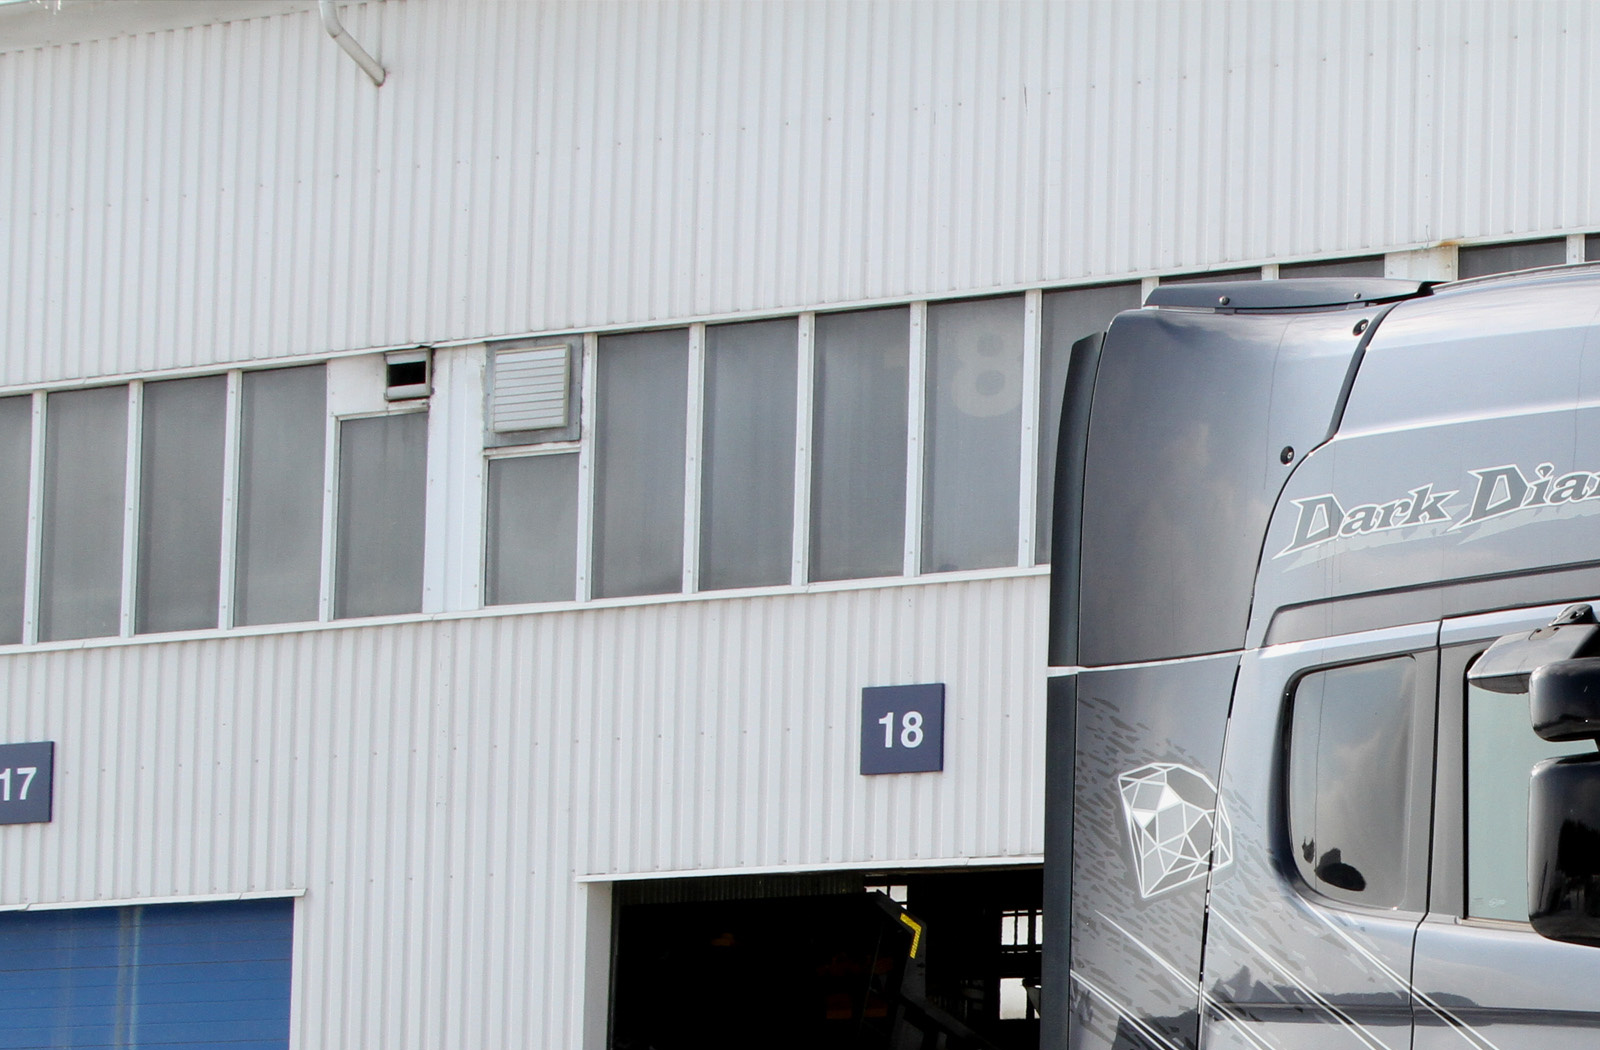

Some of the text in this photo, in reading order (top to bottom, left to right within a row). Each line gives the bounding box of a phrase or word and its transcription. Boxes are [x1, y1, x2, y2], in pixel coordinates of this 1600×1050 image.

[1272, 483, 1460, 560] Dark
[878, 710, 924, 749] 18
[0, 767, 37, 801] 17
